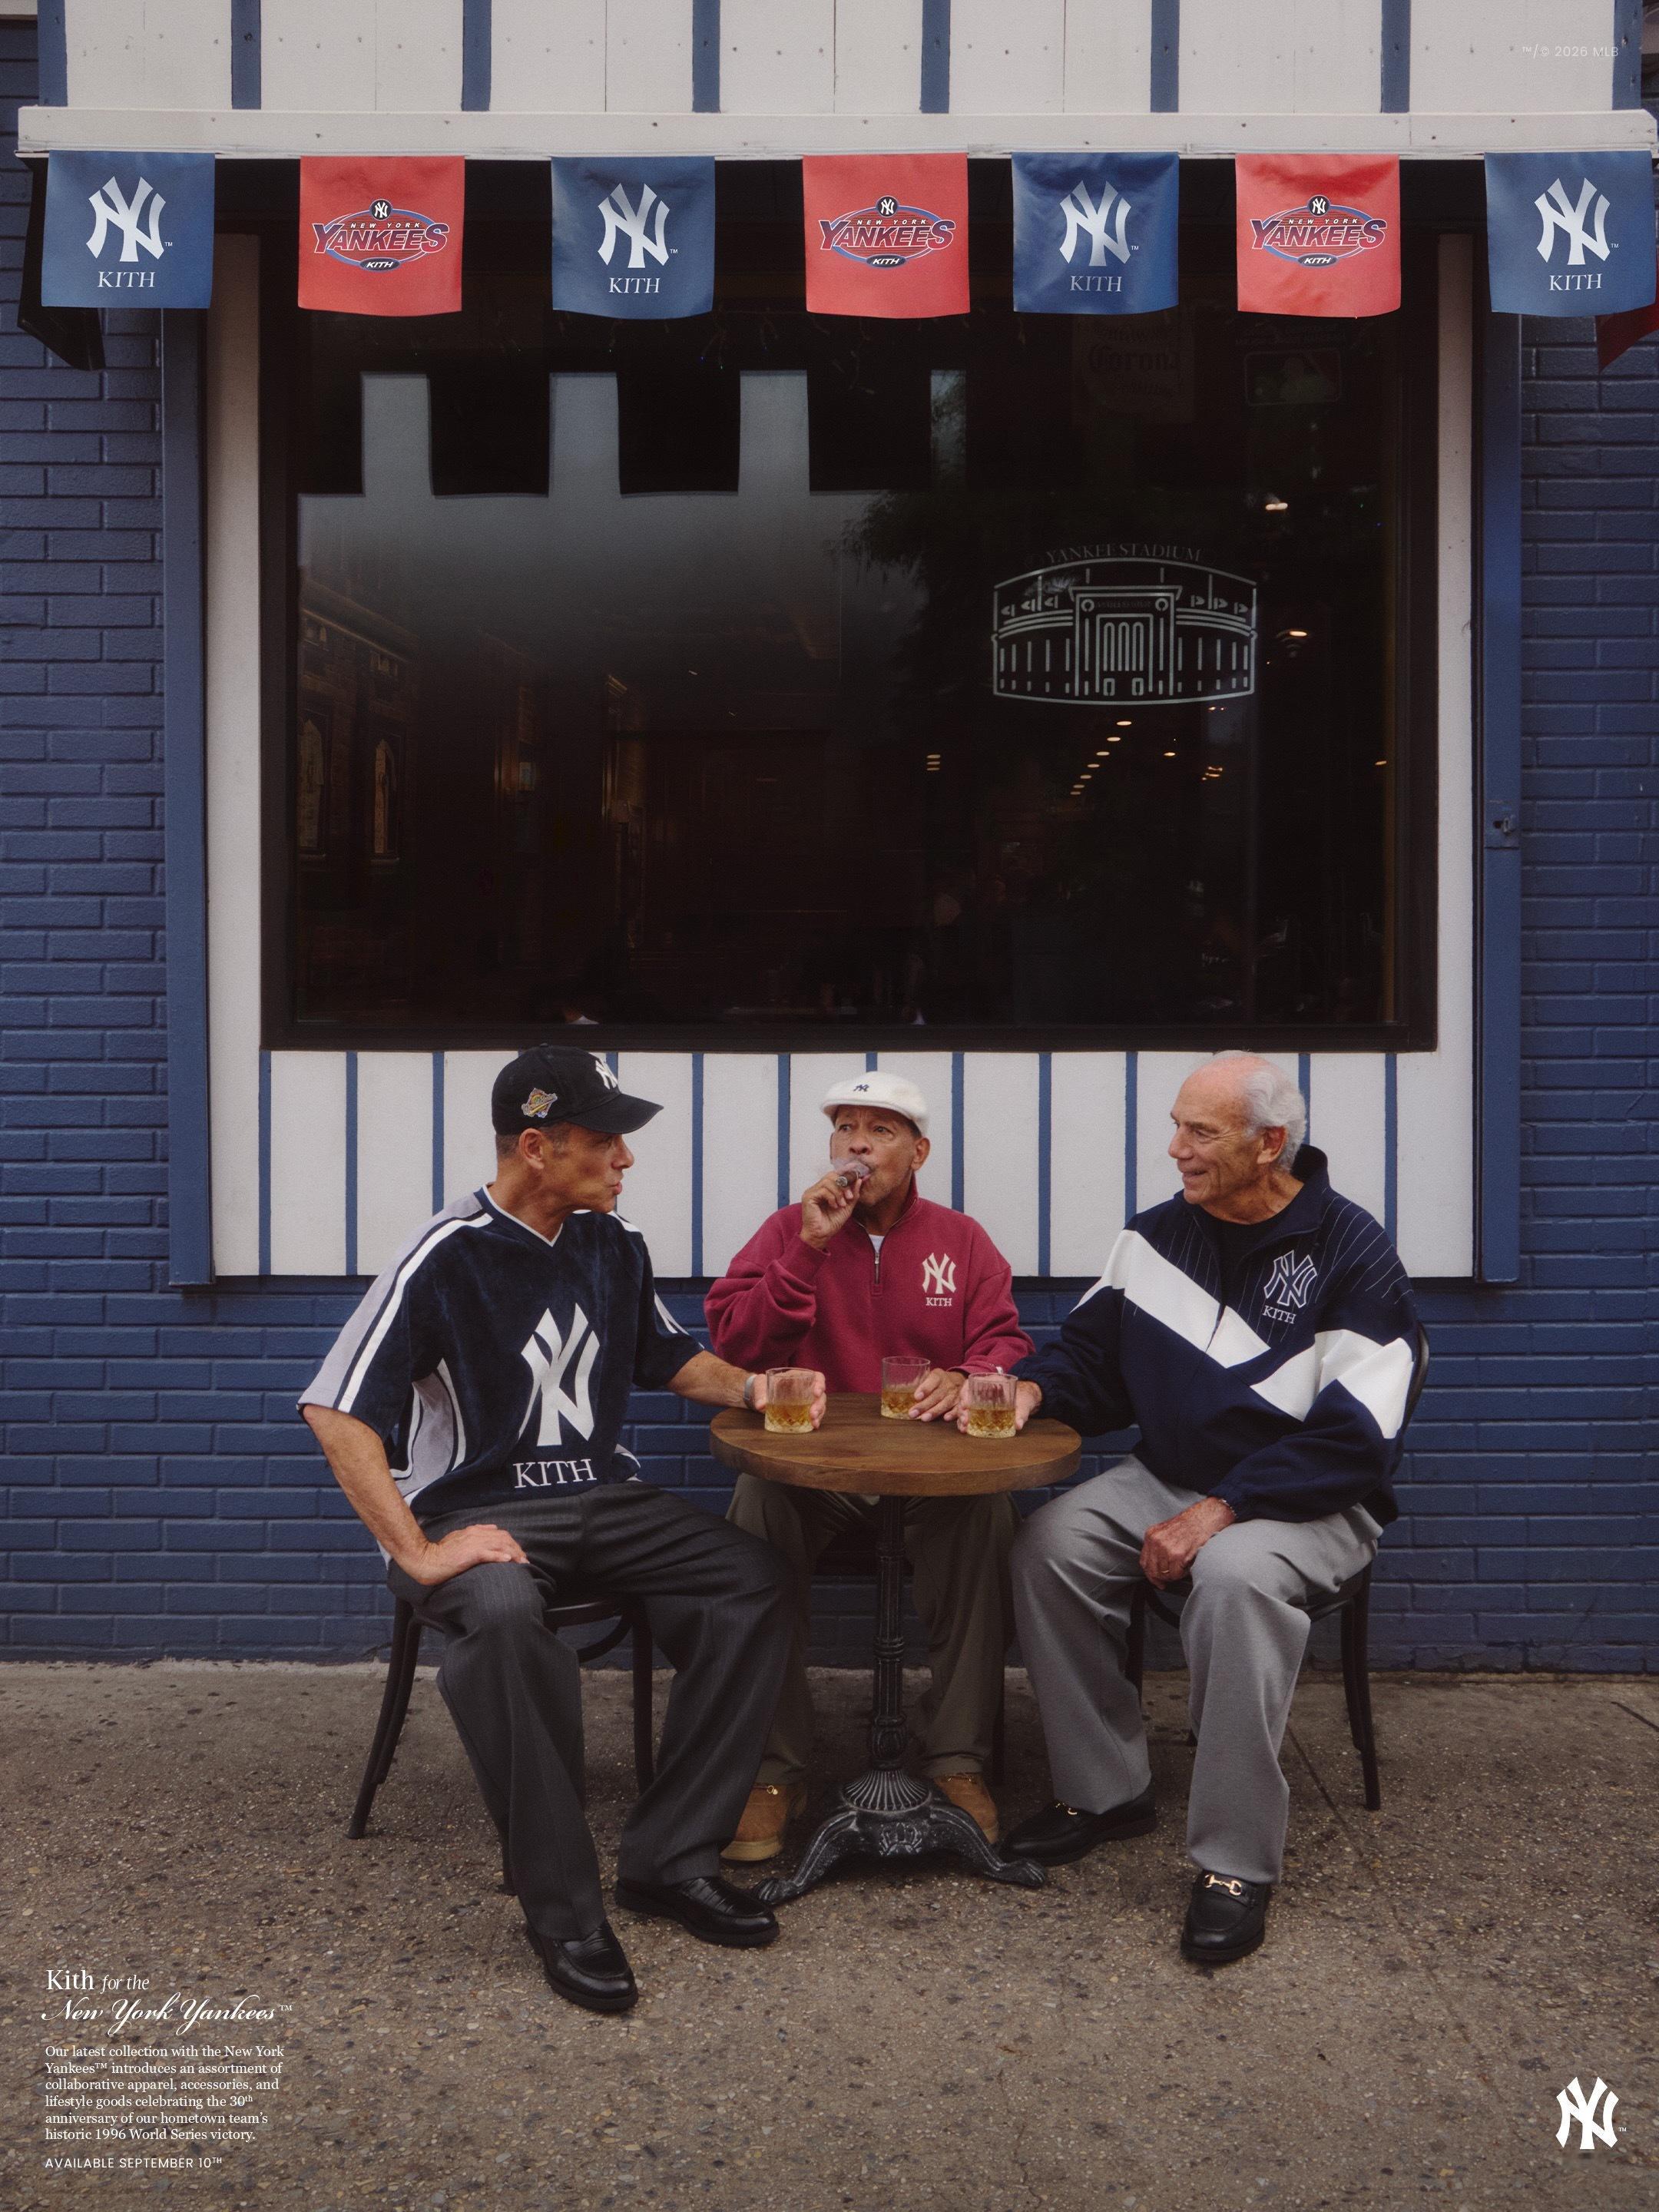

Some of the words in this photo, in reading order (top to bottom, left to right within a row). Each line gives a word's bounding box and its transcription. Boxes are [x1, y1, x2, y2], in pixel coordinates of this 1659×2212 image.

[86, 176, 166, 262] NY
[598, 183, 671, 268] NY
[1059, 180, 1131, 267] NY
[1250, 218, 1388, 250] YANKEES
[1534, 177, 1611, 265] NY
[312, 223, 449, 253] YANKEES
[818, 219, 956, 250] YANKEES
[97, 271, 155, 288] KITH
[608, 277, 661, 293] KITH
[1069, 275, 1122, 292] KITH
[1548, 273, 1602, 291] KITH
[1046, 543, 1116, 564] YANKEE
[1119, 542, 1202, 562] STADIUM
[922, 1252, 956, 1294] NY
[1263, 1249, 1318, 1308] NY
[926, 1296, 952, 1306] KITH
[1262, 1305, 1296, 1324] KITH
[512, 1459, 597, 1488] KITH
